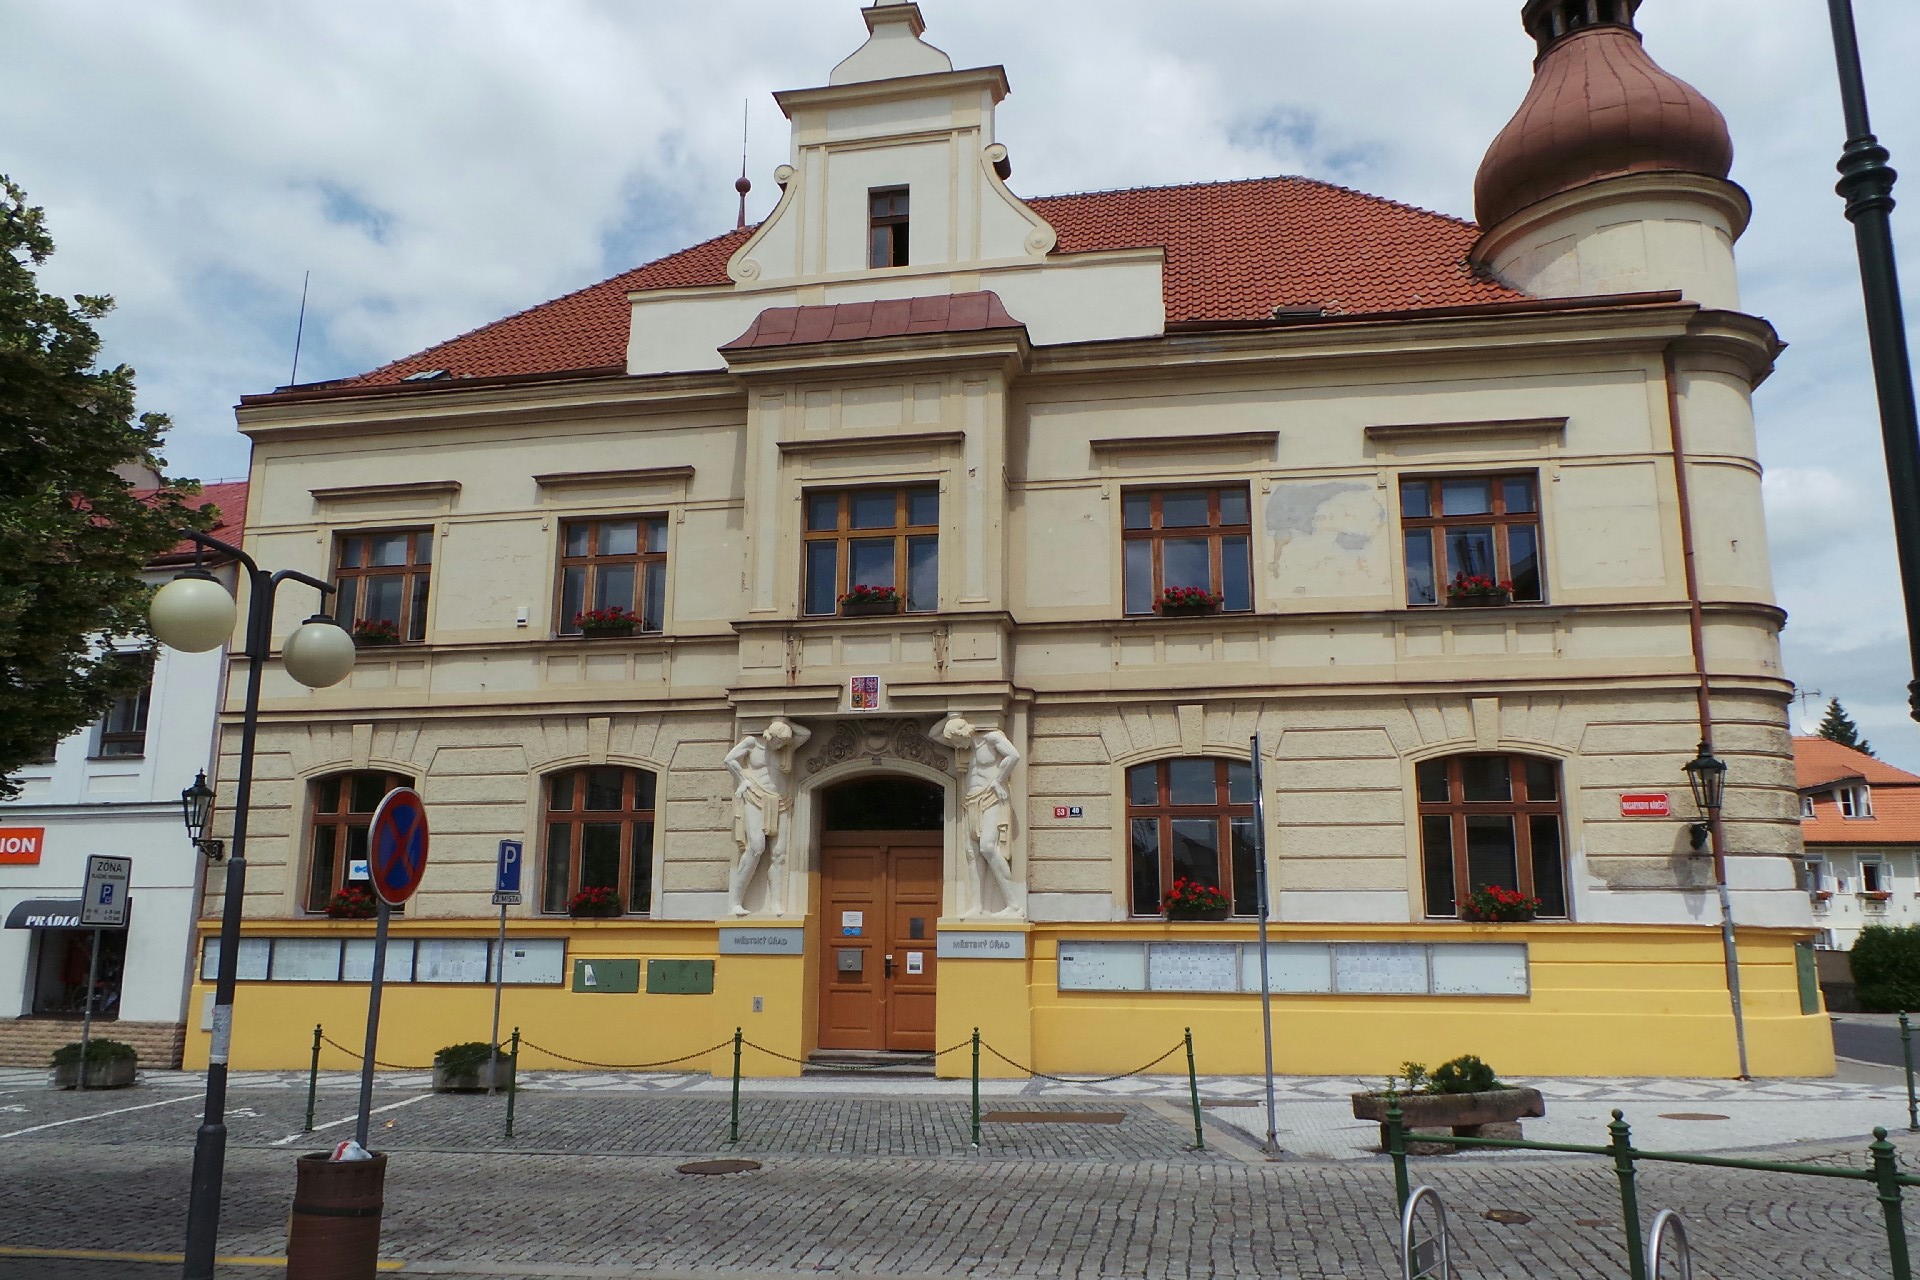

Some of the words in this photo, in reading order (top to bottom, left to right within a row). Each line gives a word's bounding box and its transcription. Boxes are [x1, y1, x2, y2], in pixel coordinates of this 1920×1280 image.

[1056, 808, 1065, 816] 53
[97, 860, 122, 873] ZÓNA
[504, 846, 517, 874] P
[24, 914, 80, 927] PRÁDLO
[953, 939, 988, 949] MĚSTSKÝ
